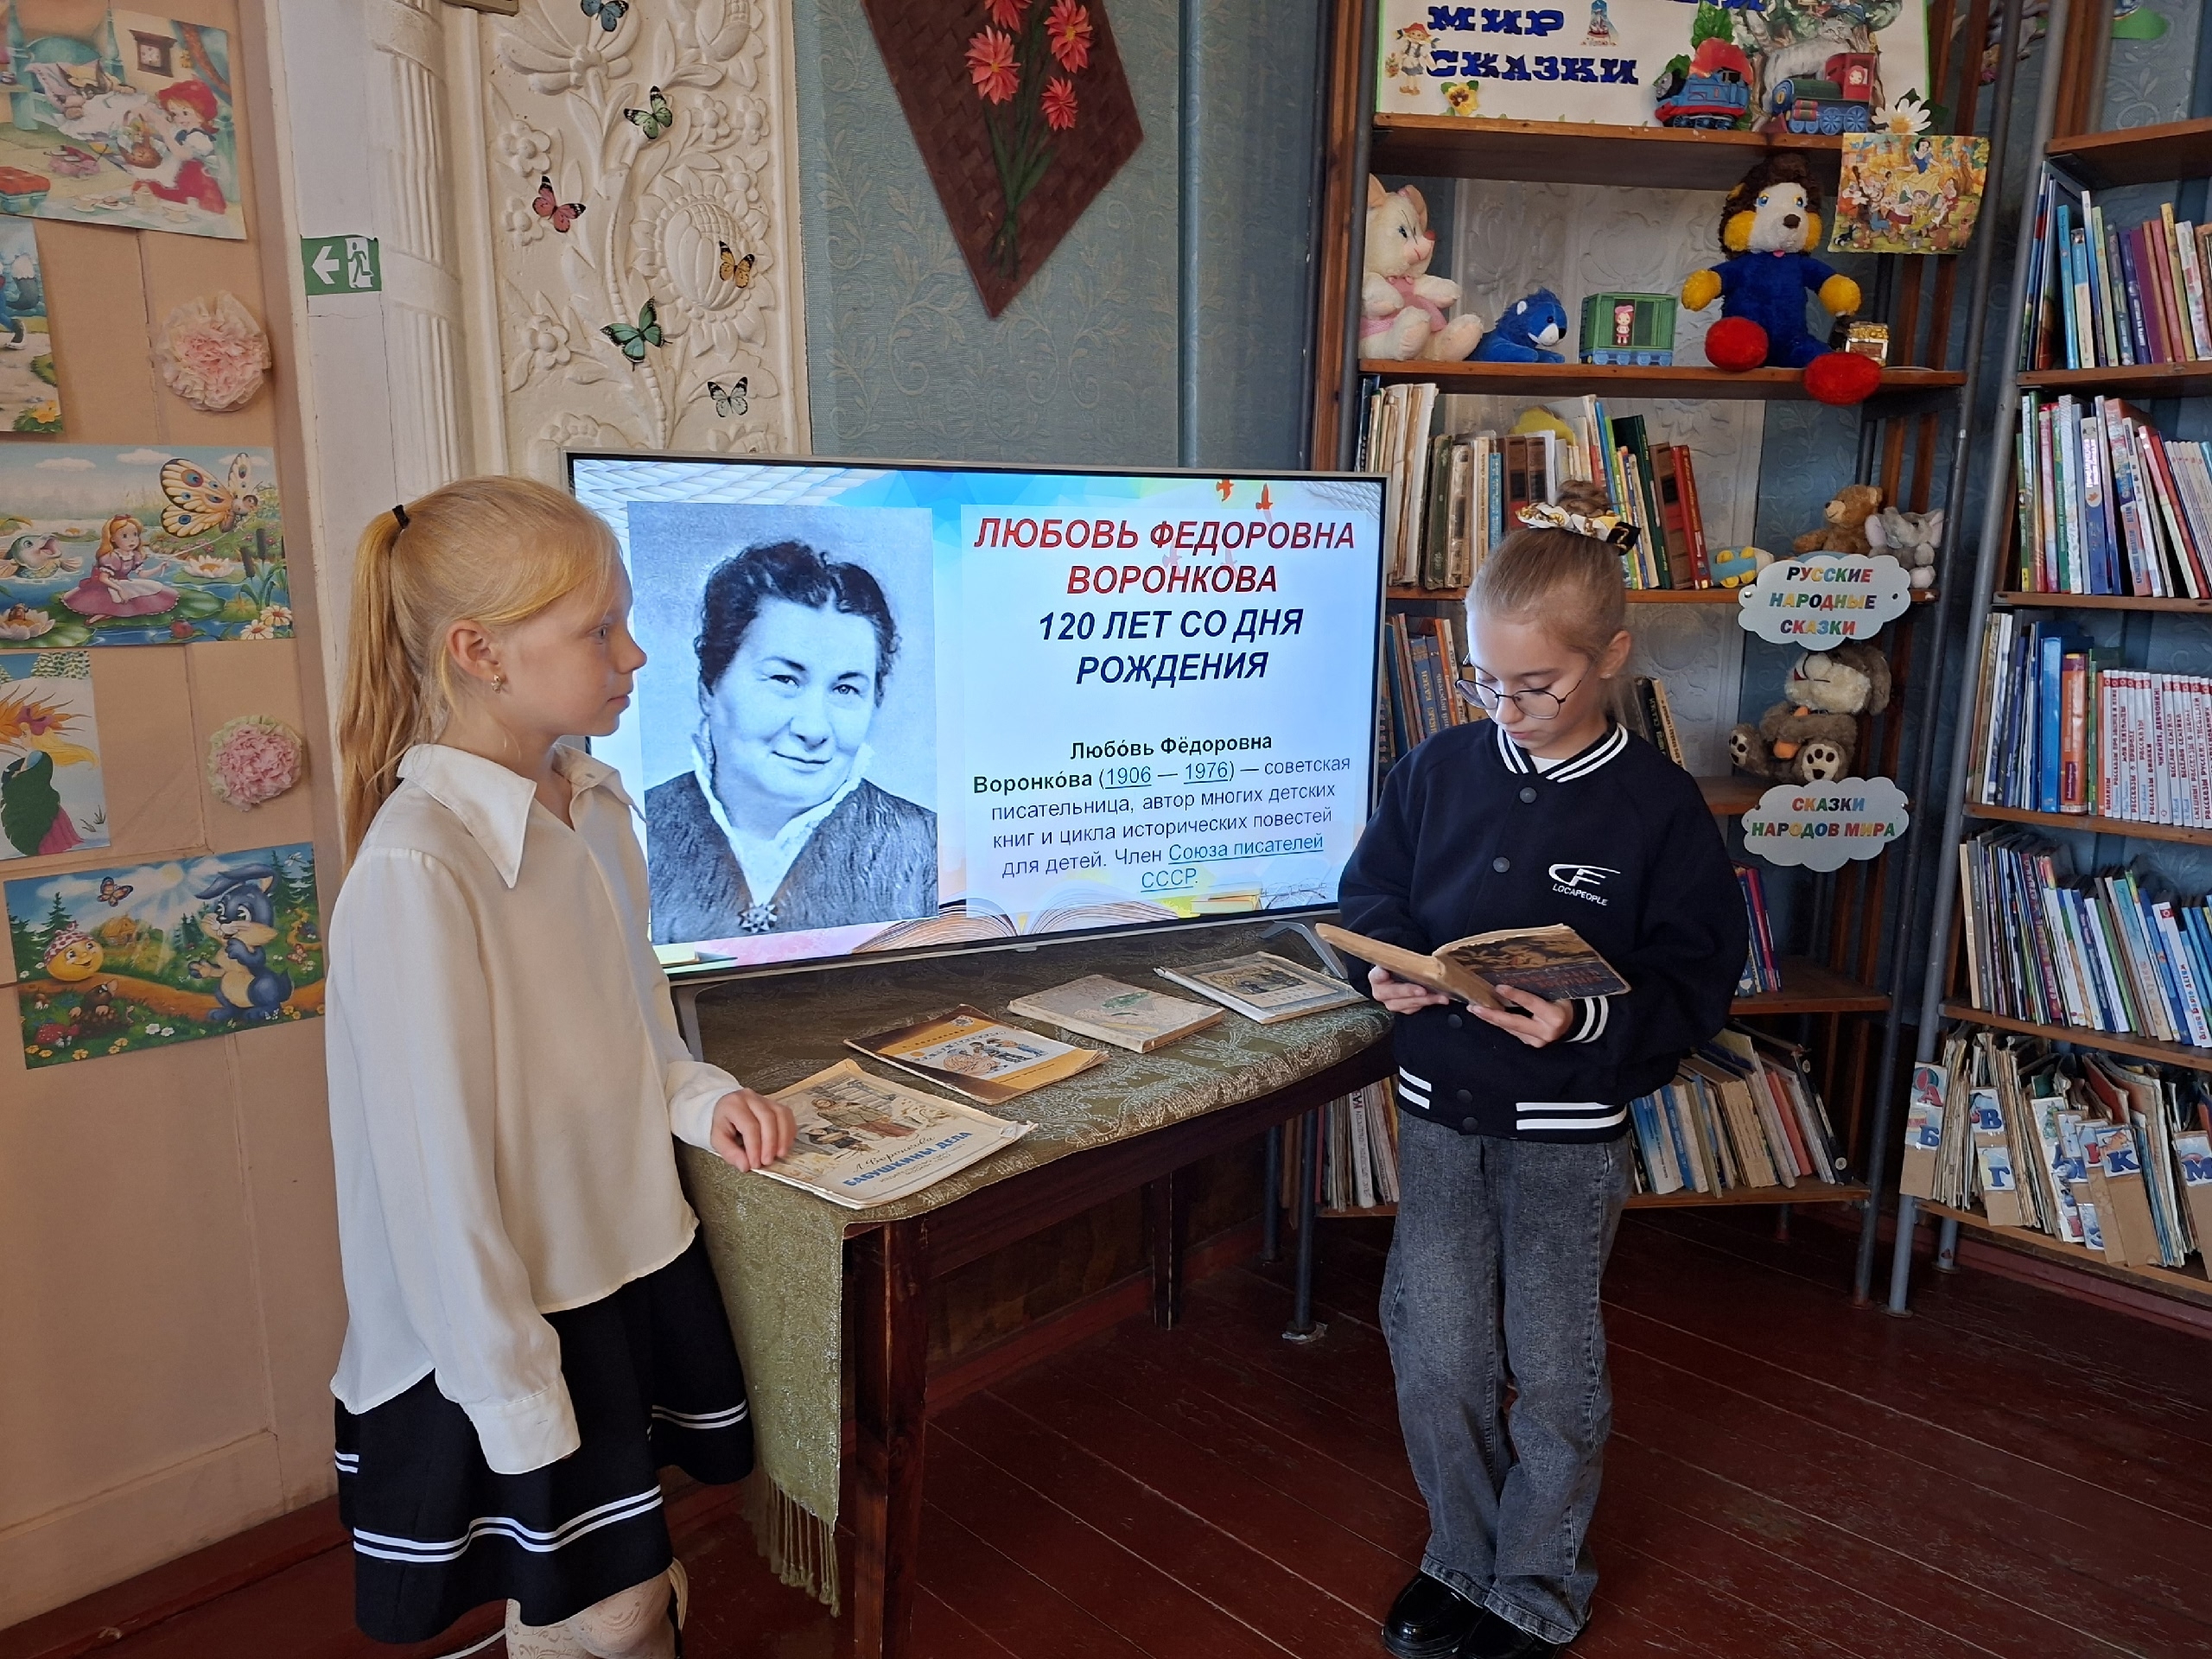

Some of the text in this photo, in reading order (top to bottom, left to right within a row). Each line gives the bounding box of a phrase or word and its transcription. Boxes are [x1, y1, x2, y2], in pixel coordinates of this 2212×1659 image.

[1427, 5, 1564, 37] МИР
[1427, 49, 1639, 86] СКАЗКИ
[974, 518, 1355, 556] ЛЮБОВЬ ФЕДОРОВНА
[1067, 565, 1277, 594] ВОРОНКОВА
[1786, 567, 1873, 582] РУССКИЕ
[1770, 593, 1877, 610] НАРОДНЫЕ
[1039, 608, 1303, 643] 120 ЛЕТ СО ДНЯ
[1780, 619, 1856, 635] СКАЗКИ
[1077, 652, 1268, 689] РОЖДЕНИЯ
[1160, 734, 1272, 755] Фёдоровна
[1098, 765, 1152, 790] (1906
[1183, 760, 1236, 785] 1976)
[1264, 756, 1351, 775] советская
[991, 782, 1336, 822] писательница, автор многих детских
[1792, 797, 1865, 811] СКАЗКИ
[993, 807, 1332, 849] книг и цикла исторических повестей
[1751, 822, 1895, 839] НАРОДОВ МИРА
[1001, 832, 1324, 879] для детей. Член Союза писателей
[1141, 868, 1198, 891] СССР.
[1552, 883, 1608, 906] LOCAPEOPLE
[1916, 1085, 1943, 1107] А
[1980, 1109, 2002, 1129] В
[1918, 1125, 1940, 1147] Б
[842, 1147, 938, 1186] БАБУШКИНЫ
[935, 1132, 973, 1149] ДЕЛА
[2107, 1150, 2141, 1173] К
[2182, 1157, 2212, 1182] М
[1988, 1166, 2010, 1187] Г
